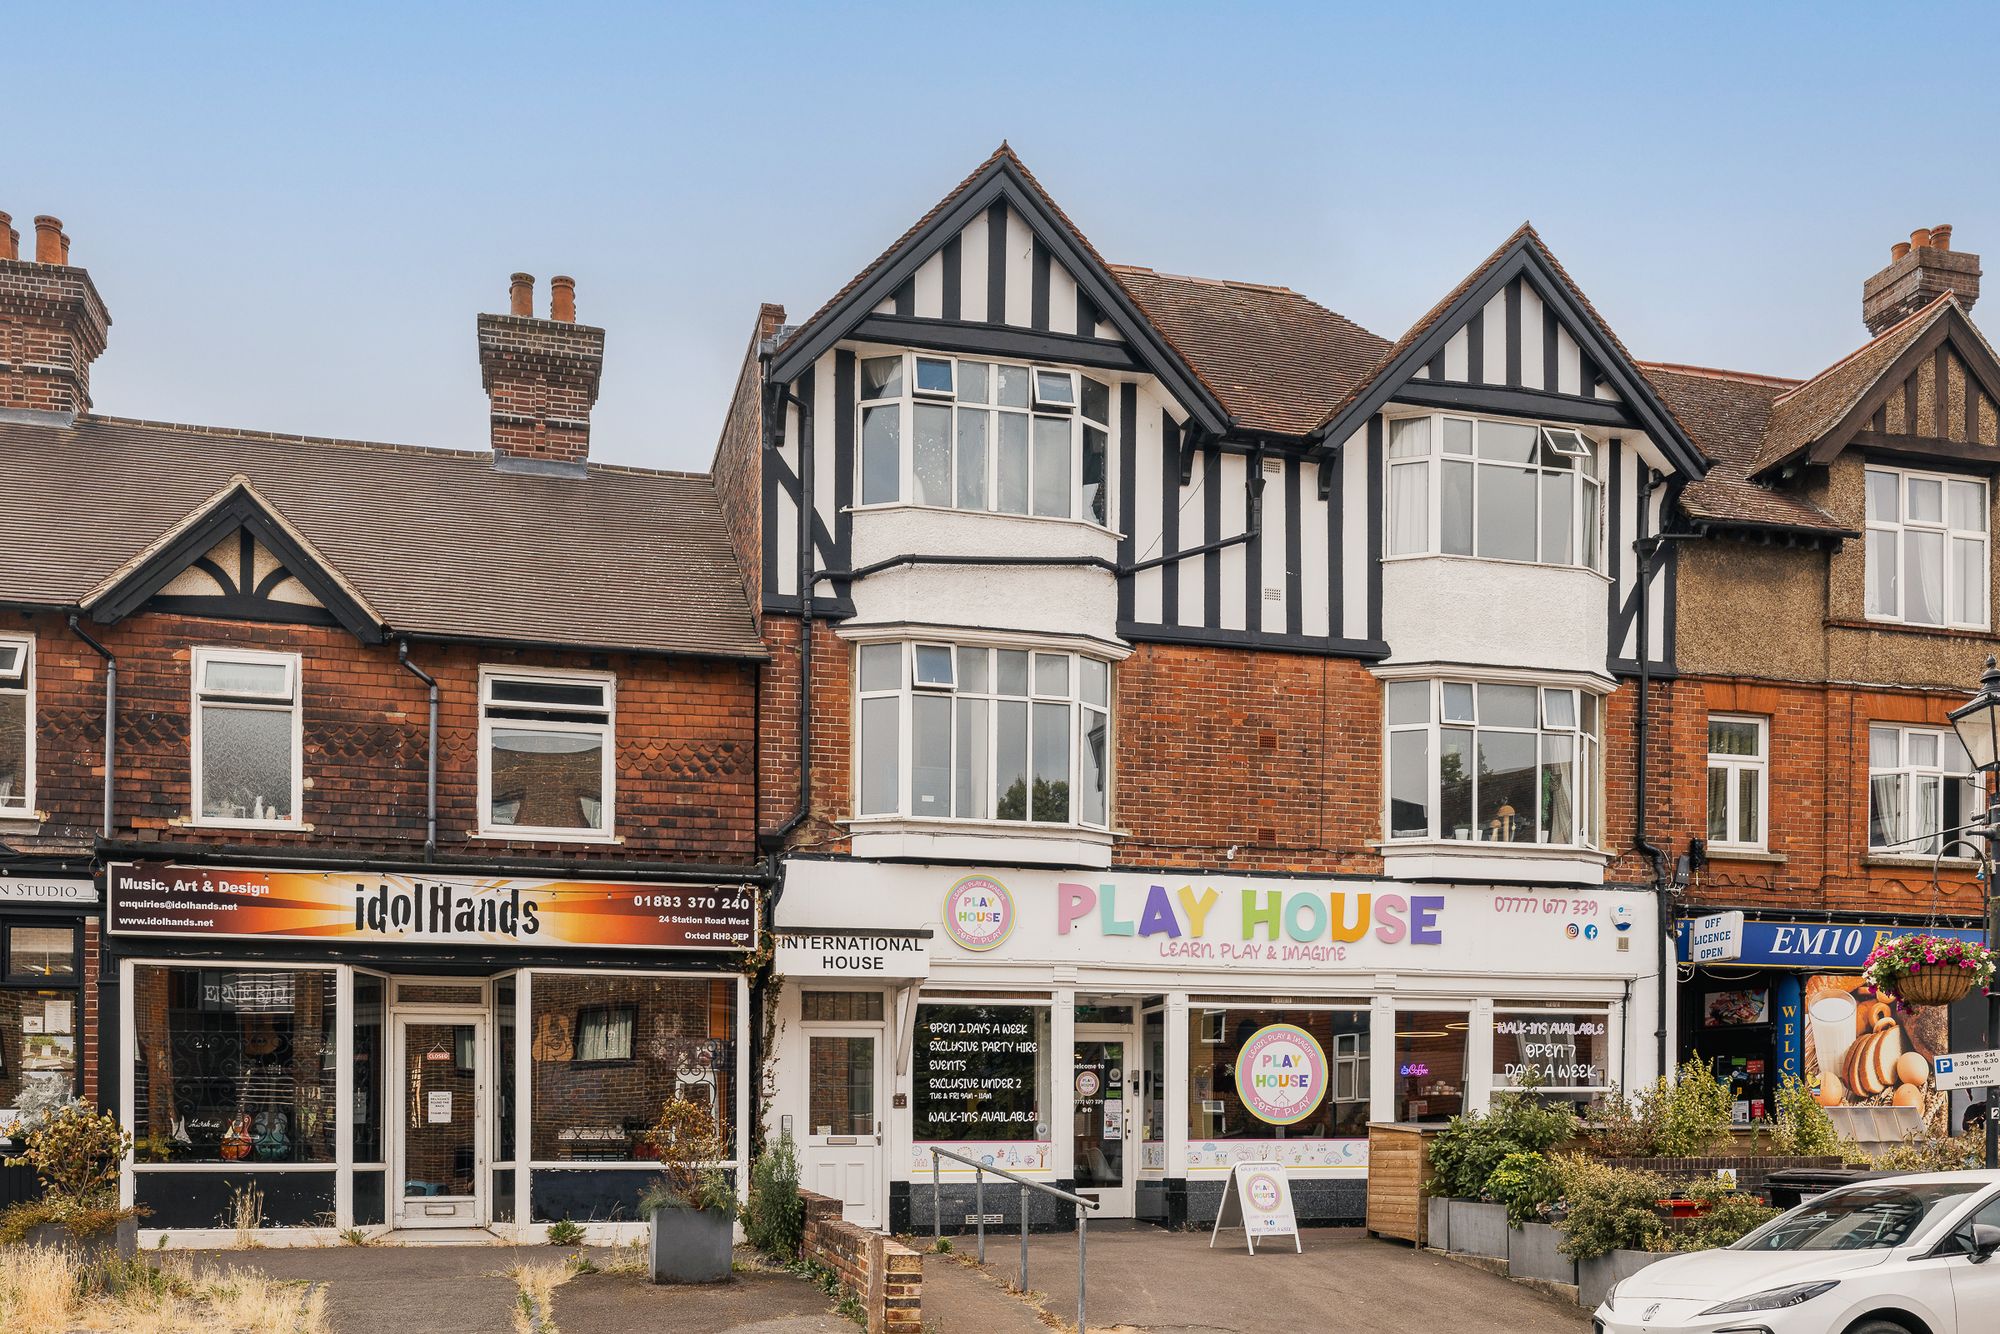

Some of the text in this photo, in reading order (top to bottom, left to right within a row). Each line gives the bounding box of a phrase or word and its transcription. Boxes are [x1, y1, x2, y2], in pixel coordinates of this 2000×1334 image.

[16, 883, 78, 897] STUDIO
[119, 877, 270, 897] Music, Art & Design
[119, 900, 238, 911] enquiries@idolhands.net
[633, 895, 750, 910] 01883 370 240
[963, 896, 995, 907] PLAY
[1494, 896, 1598, 916] 07777 677 339
[355, 883, 540, 937] idolHands
[958, 911, 1001, 922] HOUSE
[1057, 882, 1445, 945] PLAY HOUSE
[119, 916, 214, 927] www.idolhands.net
[658, 915, 750, 925] 24 Station Road West
[1705, 917, 1721, 929] OFF
[684, 932, 711, 940] Oxted
[956, 928, 1002, 944] SOFT PLAY
[1694, 930, 1731, 945] LICENCE
[1769, 926, 1862, 956] EM10
[781, 936, 924, 952] INTERNATIONAL
[1159, 941, 1347, 962] LEARN, PLAY & IMAGINE
[1700, 947, 1723, 959] OPEN
[822, 955, 884, 970] HOUSE
[929, 1022, 956, 1034] OPEN
[966, 1023, 990, 1035] DAYS
[993, 1023, 1000, 1034] A
[1002, 1023, 1028, 1035] WEEK
[1497, 1021, 1605, 1036] WALK-INS AVAILABLE
[929, 1040, 1038, 1053] EXCLUSIVE PARTY HIRE
[1525, 1043, 1577, 1058] OPEN 7
[929, 1059, 967, 1071] EVENTS
[1262, 1054, 1302, 1068] PLAY
[1940, 1060, 1950, 1072] P
[1544, 1063, 1554, 1078] A
[1558, 1063, 1597, 1079] WEEK
[929, 1078, 1022, 1089] EXCLUSIVE UNDER 2
[1255, 1074, 1309, 1088] HOUSE
[929, 1092, 942, 1100] TUE
[1253, 1096, 1311, 1117] SOFT PLAY
[928, 1111, 978, 1123] WALK-INS
